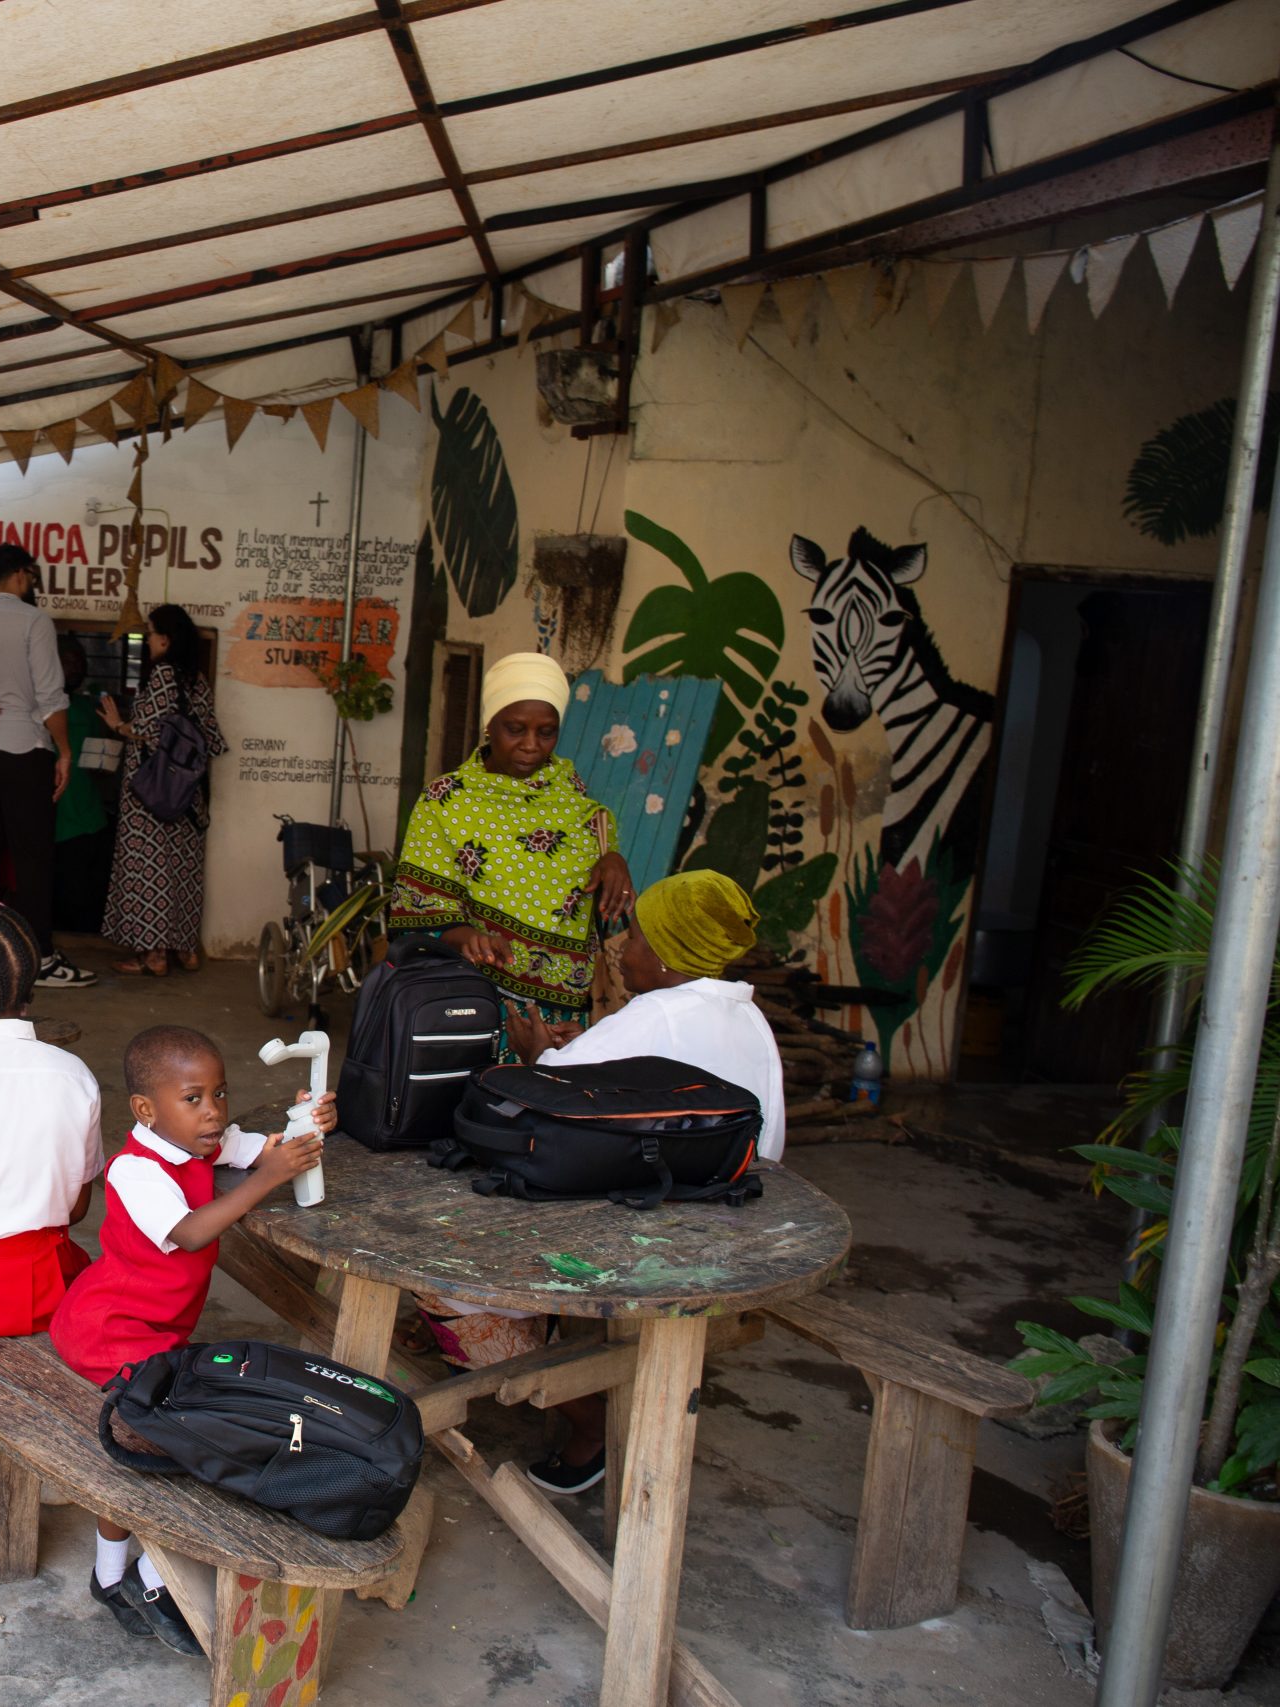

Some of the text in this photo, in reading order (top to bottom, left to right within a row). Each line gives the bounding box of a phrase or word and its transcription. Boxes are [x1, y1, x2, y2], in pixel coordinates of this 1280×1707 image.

[99, 524, 223, 571] PUPILS
[237, 529, 249, 543] In
[254, 528, 287, 547] loving
[289, 535, 334, 550] memory
[375, 536, 418, 555] beloved
[235, 543, 269, 558] friend
[318, 548, 341, 561] who
[379, 554, 409, 567] away
[234, 558, 249, 568] on
[363, 564, 382, 575] you
[32, 565, 135, 598] ALLER
[265, 580, 279, 593] to
[282, 582, 302, 593] our
[308, 581, 346, 595] schoo
[310, 572, 348, 585] suppor
[376, 576, 404, 587] gave
[51, 596, 90, 611] SCHOOL
[238, 590, 259, 602] will
[242, 738, 287, 751] GERMANY
